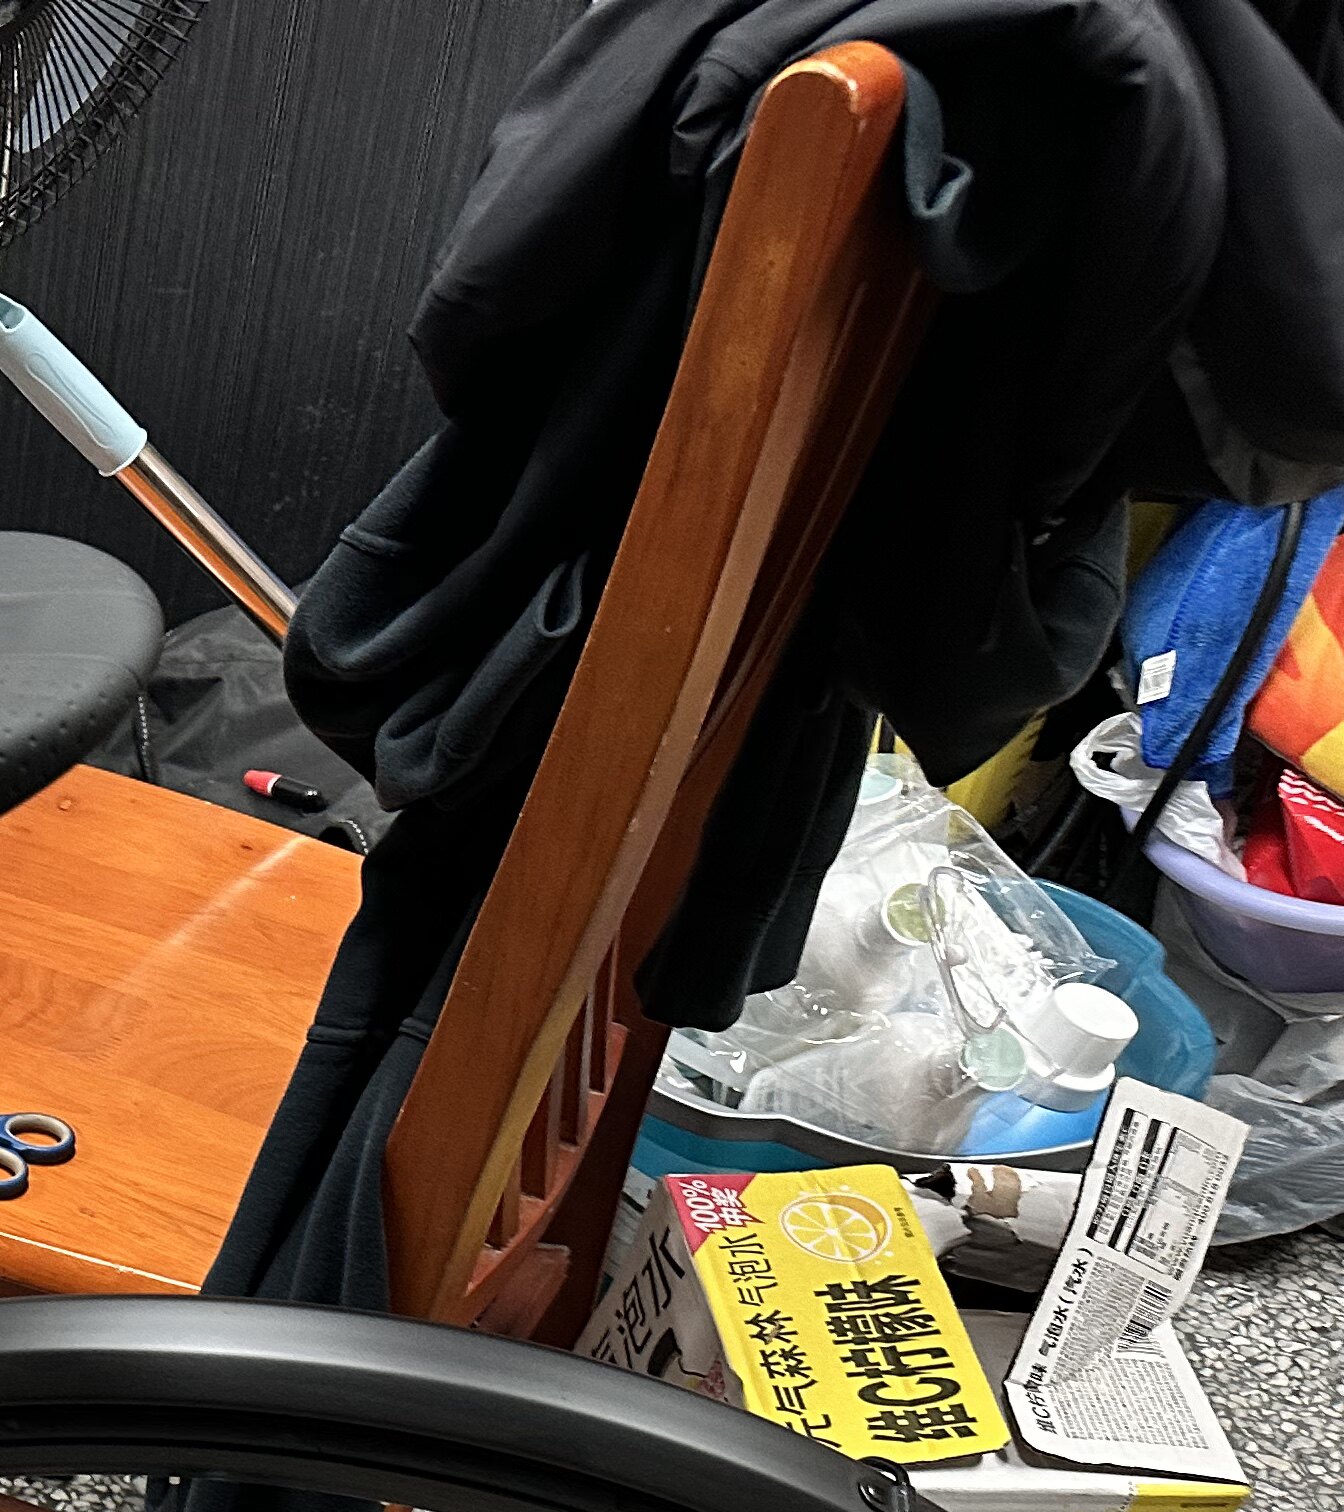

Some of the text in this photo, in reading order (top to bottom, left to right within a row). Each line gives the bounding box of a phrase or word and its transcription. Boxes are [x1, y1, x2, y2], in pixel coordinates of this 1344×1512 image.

[679, 1179, 723, 1233] 100%
[711, 1186, 742, 1226] 中奖
[718, 1232, 779, 1307] 气泡水
[814, 1274, 979, 1443] 维C柠檬味
